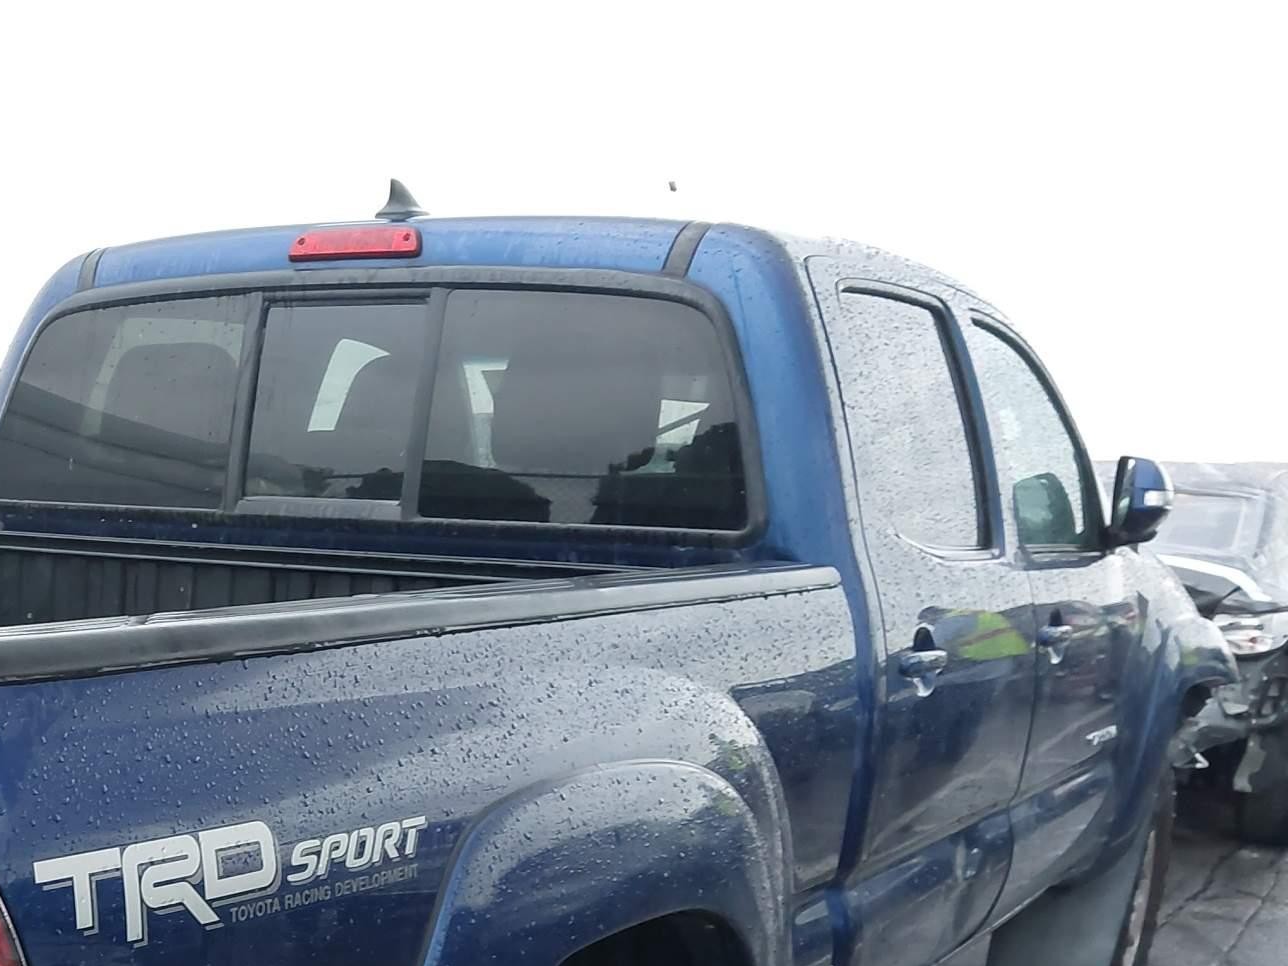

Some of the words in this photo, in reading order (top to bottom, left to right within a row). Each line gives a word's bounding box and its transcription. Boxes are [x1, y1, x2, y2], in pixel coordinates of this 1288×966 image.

[32, 820, 280, 946] TRD
[287, 815, 427, 884] SPORT
[230, 902, 281, 923] TOYOTA
[284, 886, 332, 910] RACING
[335, 864, 420, 897] DEVELOPMENT
